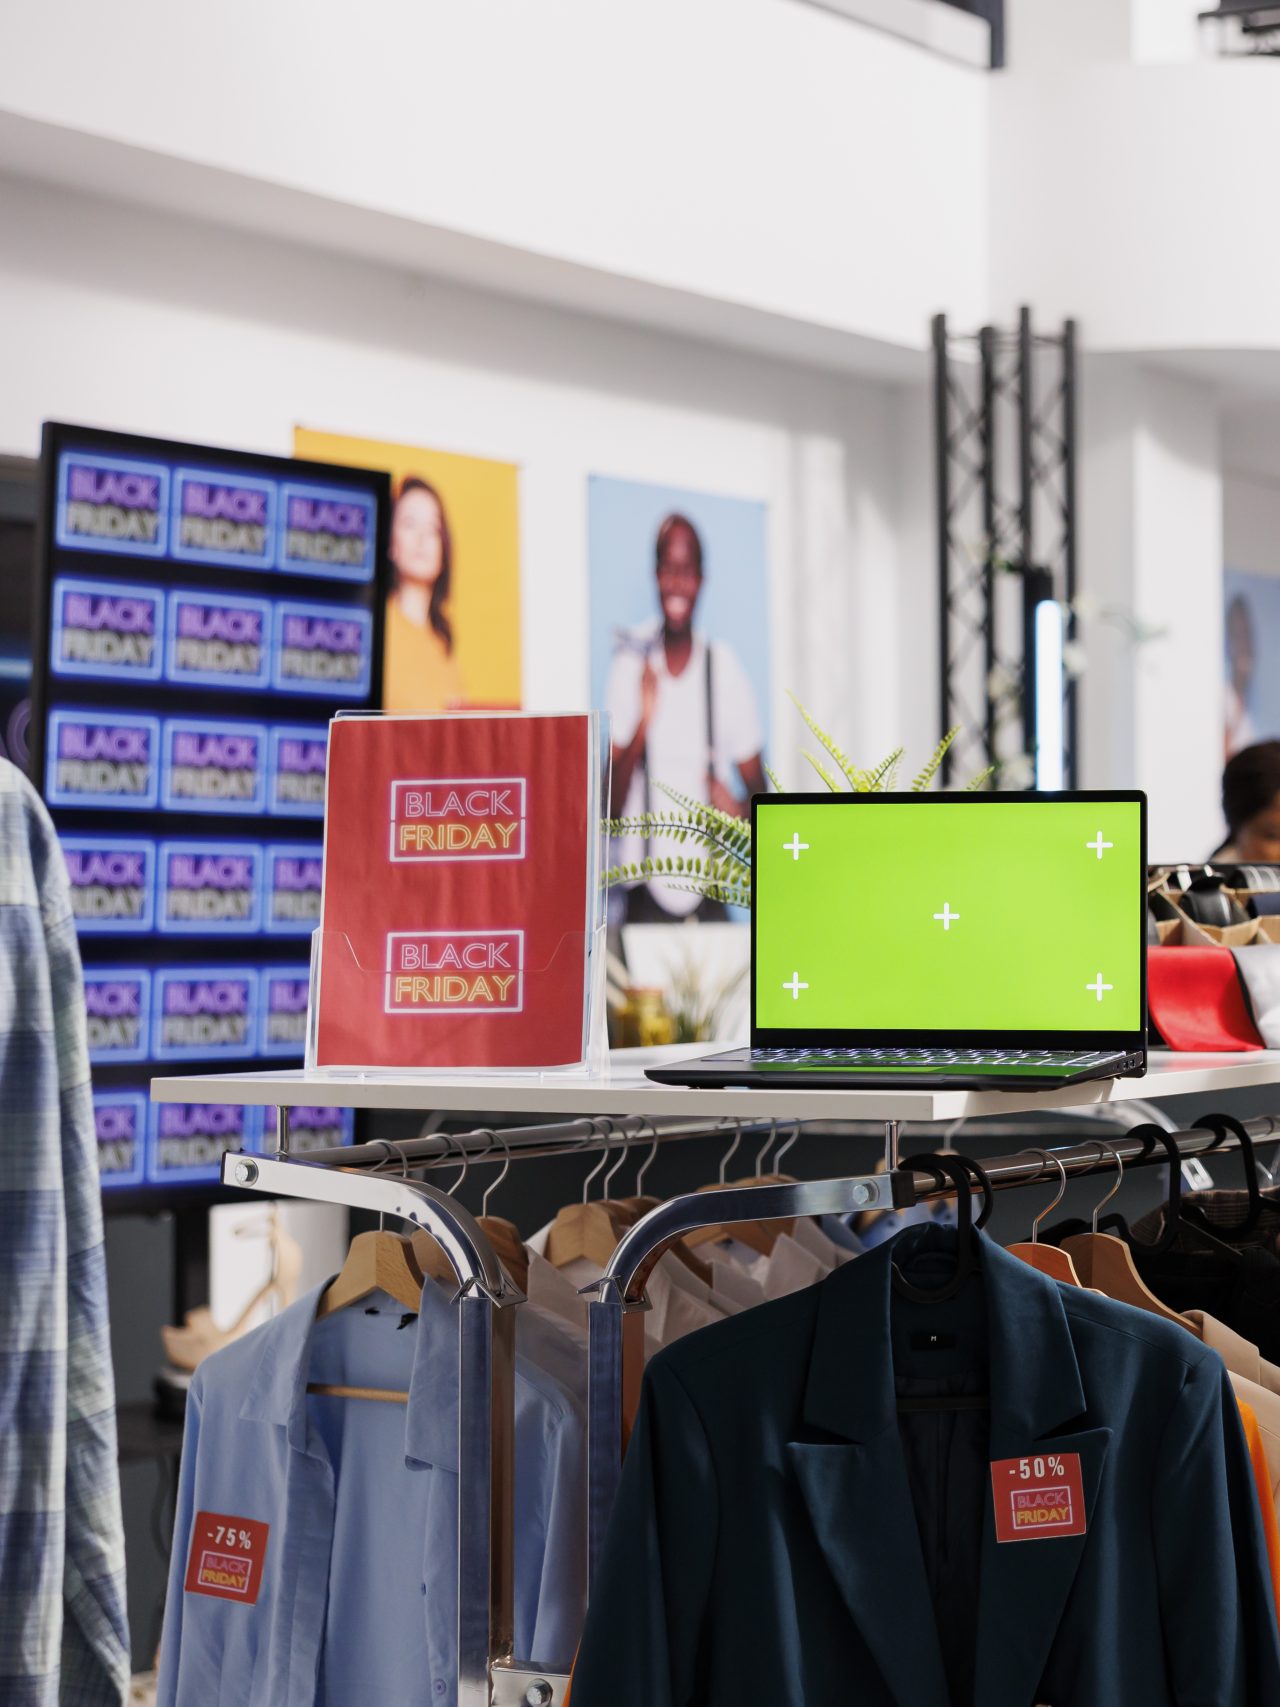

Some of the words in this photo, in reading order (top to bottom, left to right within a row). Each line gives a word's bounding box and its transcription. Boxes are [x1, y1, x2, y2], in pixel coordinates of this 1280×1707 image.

[69, 466, 159, 509] BLACK
[182, 481, 266, 524] BLACK
[67, 501, 159, 542] FRIDAY
[288, 497, 366, 536] BLACK
[181, 516, 266, 555] FRIDAY
[287, 528, 366, 564] FRIDAY
[64, 592, 154, 633] BLACK
[178, 603, 262, 642] BLACK
[62, 627, 154, 668] FRIDAY
[282, 613, 362, 652] BLACK
[176, 636, 261, 675] FRIDAY
[281, 648, 361, 683] FRIDAY
[60, 723, 149, 762] BLACK
[173, 732, 257, 769] BLACK
[279, 738, 326, 772] BLA
[58, 758, 149, 794] FRIDAY
[171, 765, 256, 798] FRIDAY
[404, 790, 513, 817] BLACK
[399, 822, 518, 851] FRIDAY
[169, 855, 252, 889] BLACK
[275, 857, 323, 891] BLA
[167, 888, 250, 920] FRIDAY
[401, 942, 511, 970] BLACK
[164, 982, 247, 1015] BLACK
[394, 974, 515, 1003] FRIDAY
[163, 1013, 246, 1046] FRIDAY
[160, 1103, 243, 1137] BLACK
[1009, 1456, 1064, 1479] -50%
[1016, 1506, 1068, 1524] FRIDAY
[1017, 1491, 1066, 1509] BLACK
[207, 1525, 251, 1550] -75%
[202, 1568, 245, 1588] FRIDAY
[206, 1556, 246, 1574] BLACK
